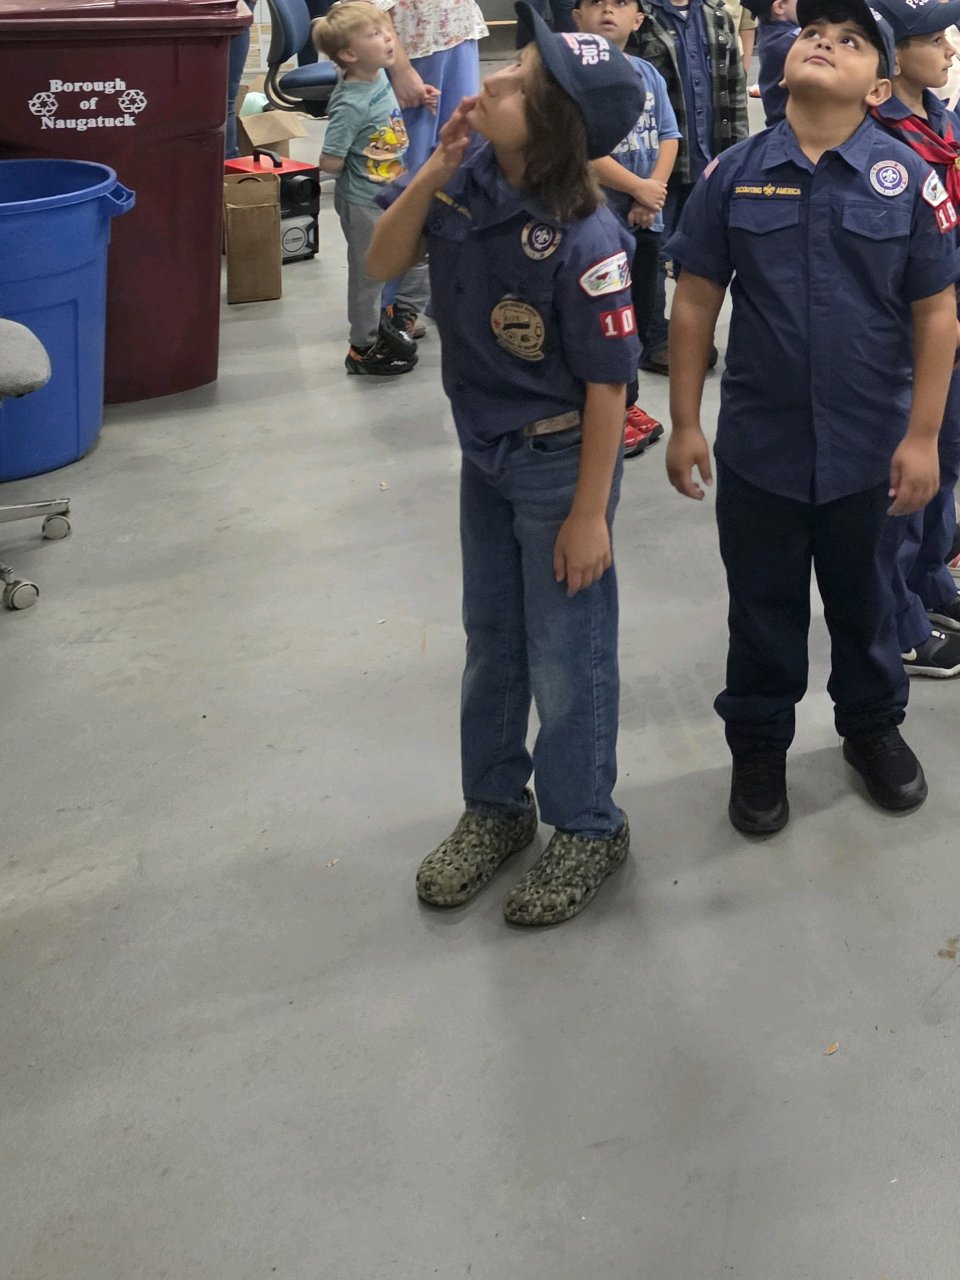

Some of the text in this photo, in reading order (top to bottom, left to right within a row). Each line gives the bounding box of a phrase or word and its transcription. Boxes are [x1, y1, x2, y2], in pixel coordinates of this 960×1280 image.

[49, 78, 126, 94] Borough
[79, 97, 98, 110] of
[40, 114, 136, 131] Naugatuck
[605, 310, 634, 337] 10
